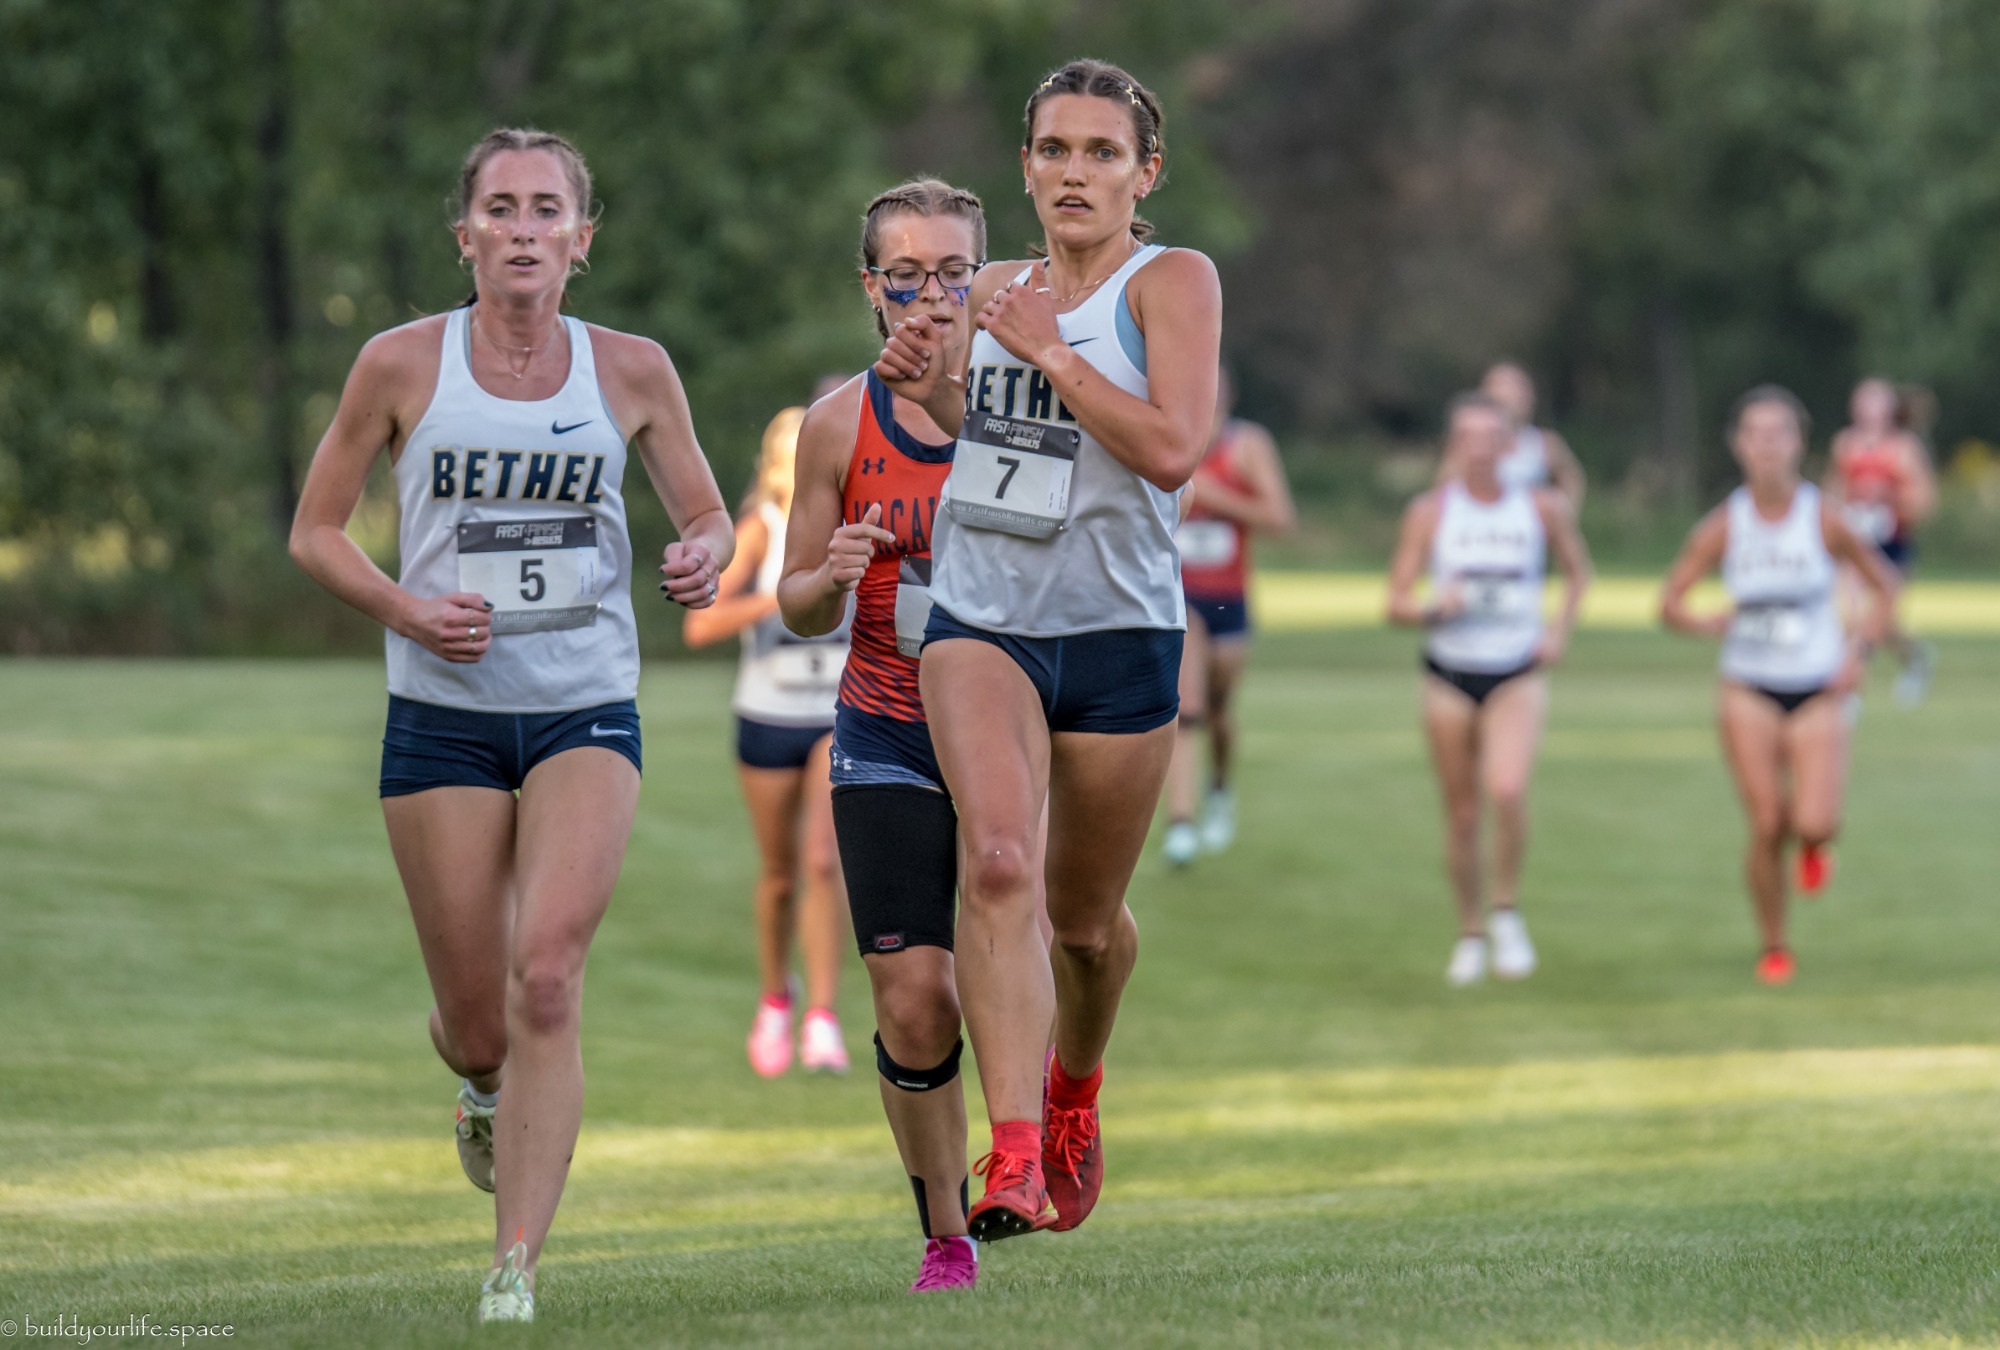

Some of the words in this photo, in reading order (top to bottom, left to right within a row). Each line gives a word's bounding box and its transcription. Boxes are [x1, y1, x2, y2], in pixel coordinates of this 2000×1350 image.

[984, 418, 1010, 434] FAST
[1010, 422, 1045, 441] FINISH
[1012, 436, 1040, 450] RESULTS
[431, 449, 605, 504] BETHEL
[995, 456, 1021, 500] 7
[495, 524, 526, 539] FAST
[527, 522, 564, 537] FINISH
[520, 558, 546, 602] 5
